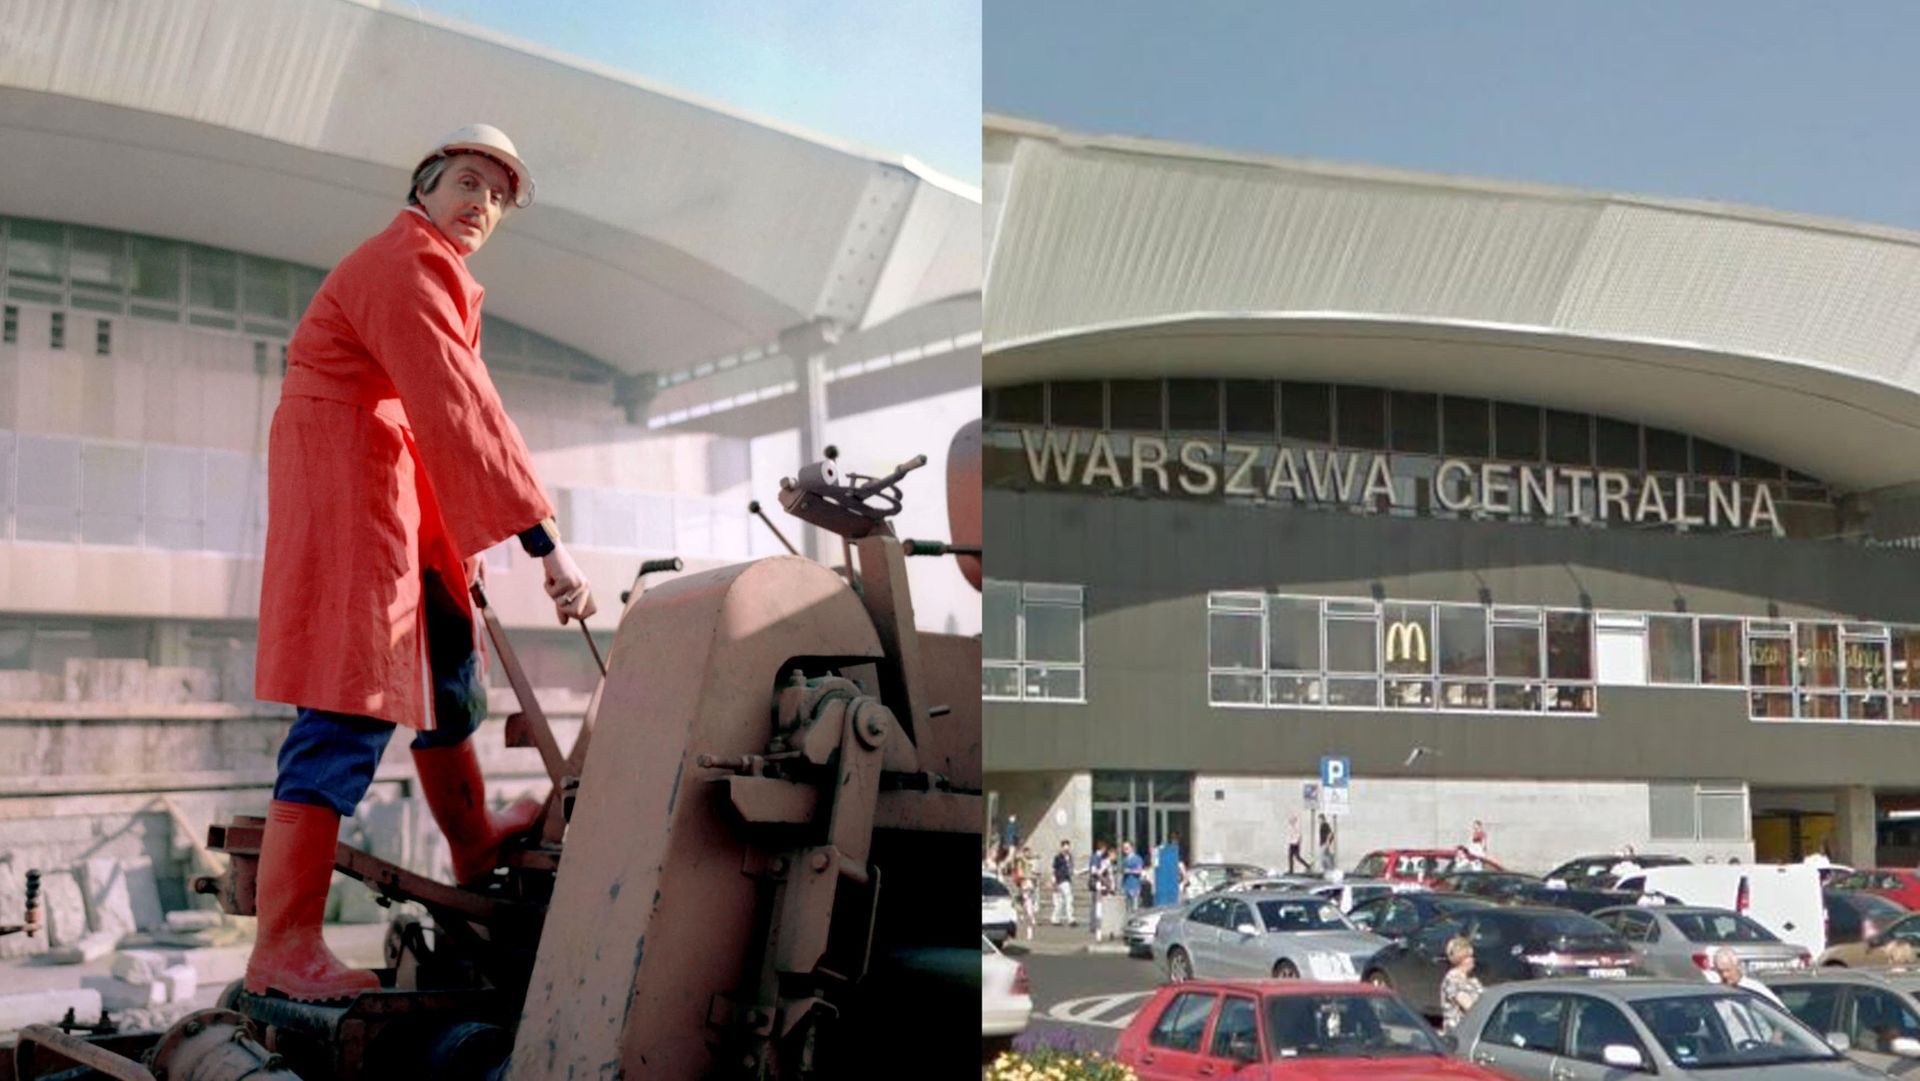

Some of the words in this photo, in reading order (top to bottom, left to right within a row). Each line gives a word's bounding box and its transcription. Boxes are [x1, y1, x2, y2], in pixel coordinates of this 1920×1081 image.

[1020, 429, 1398, 506] WARSZAWA
[1435, 459, 1786, 537] CENTRALNA
[1328, 759, 1344, 784] P
